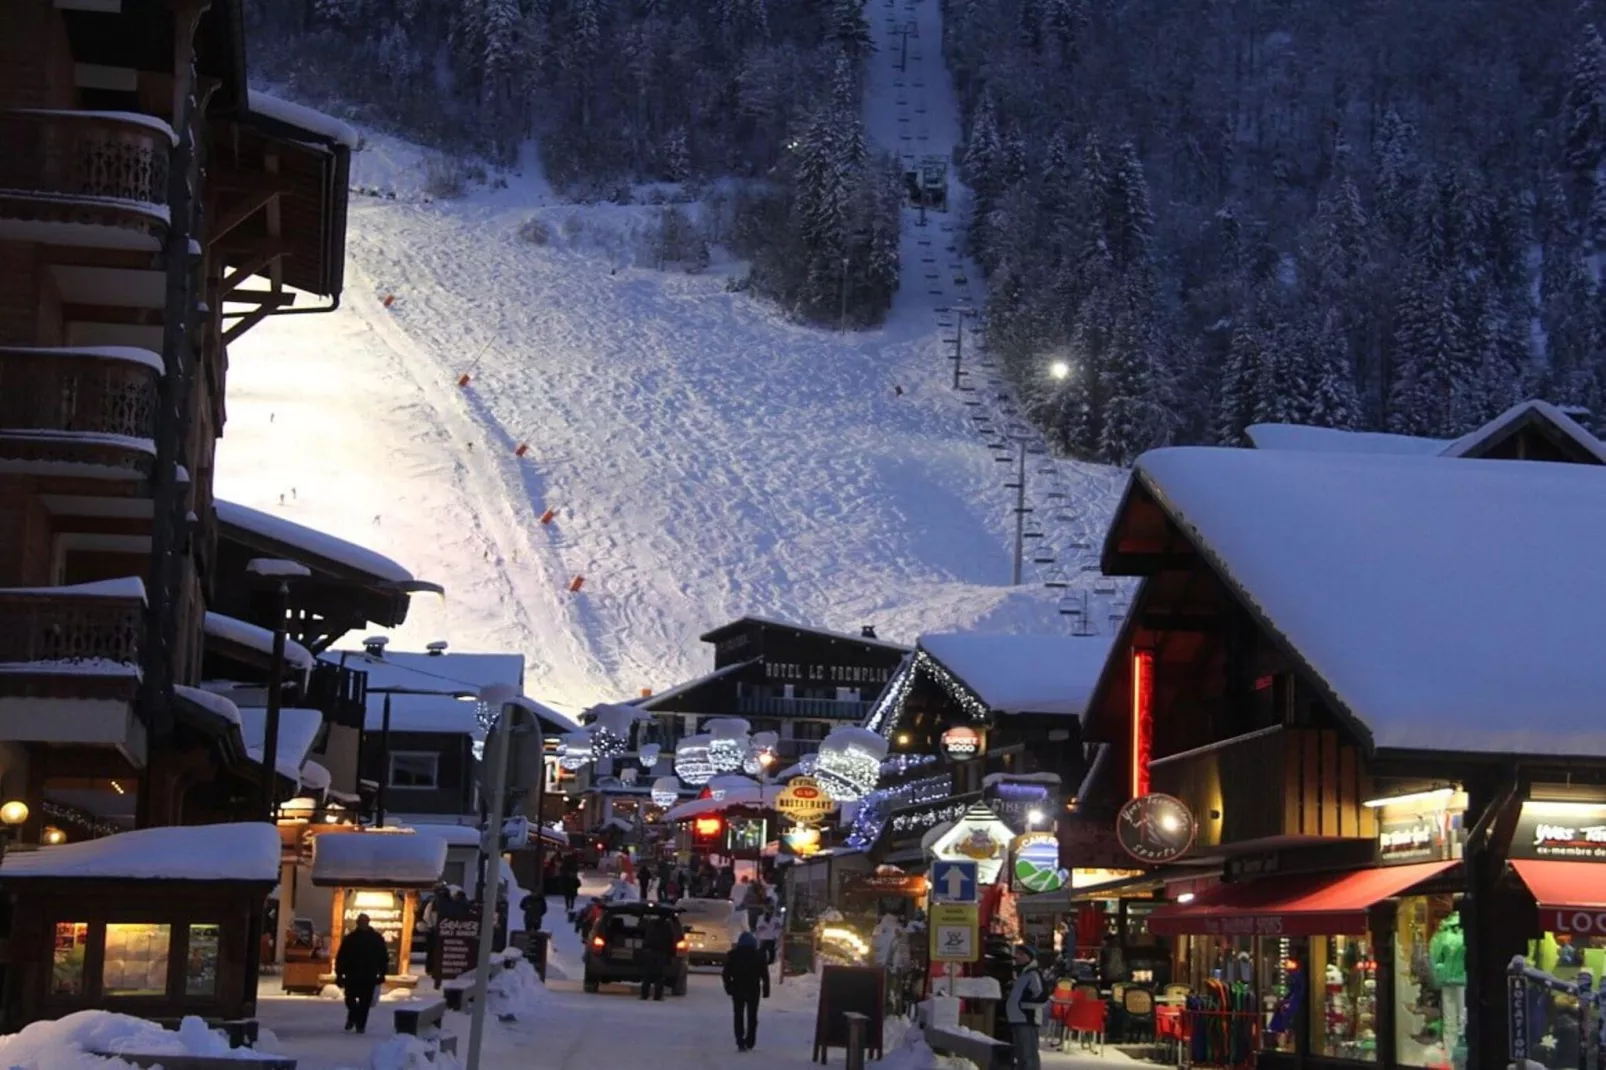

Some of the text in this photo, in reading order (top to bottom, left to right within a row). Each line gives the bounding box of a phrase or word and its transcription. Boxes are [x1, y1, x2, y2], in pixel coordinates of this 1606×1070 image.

[765, 663, 888, 682] HOTEL LE TREMPLIN
[948, 744, 976, 752] 2000
[1533, 824, 1576, 846] Yves
[1132, 844, 1176, 858] Sports
[1536, 847, 1592, 856] ex-membre
[1514, 979, 1526, 1057] LOCATION
